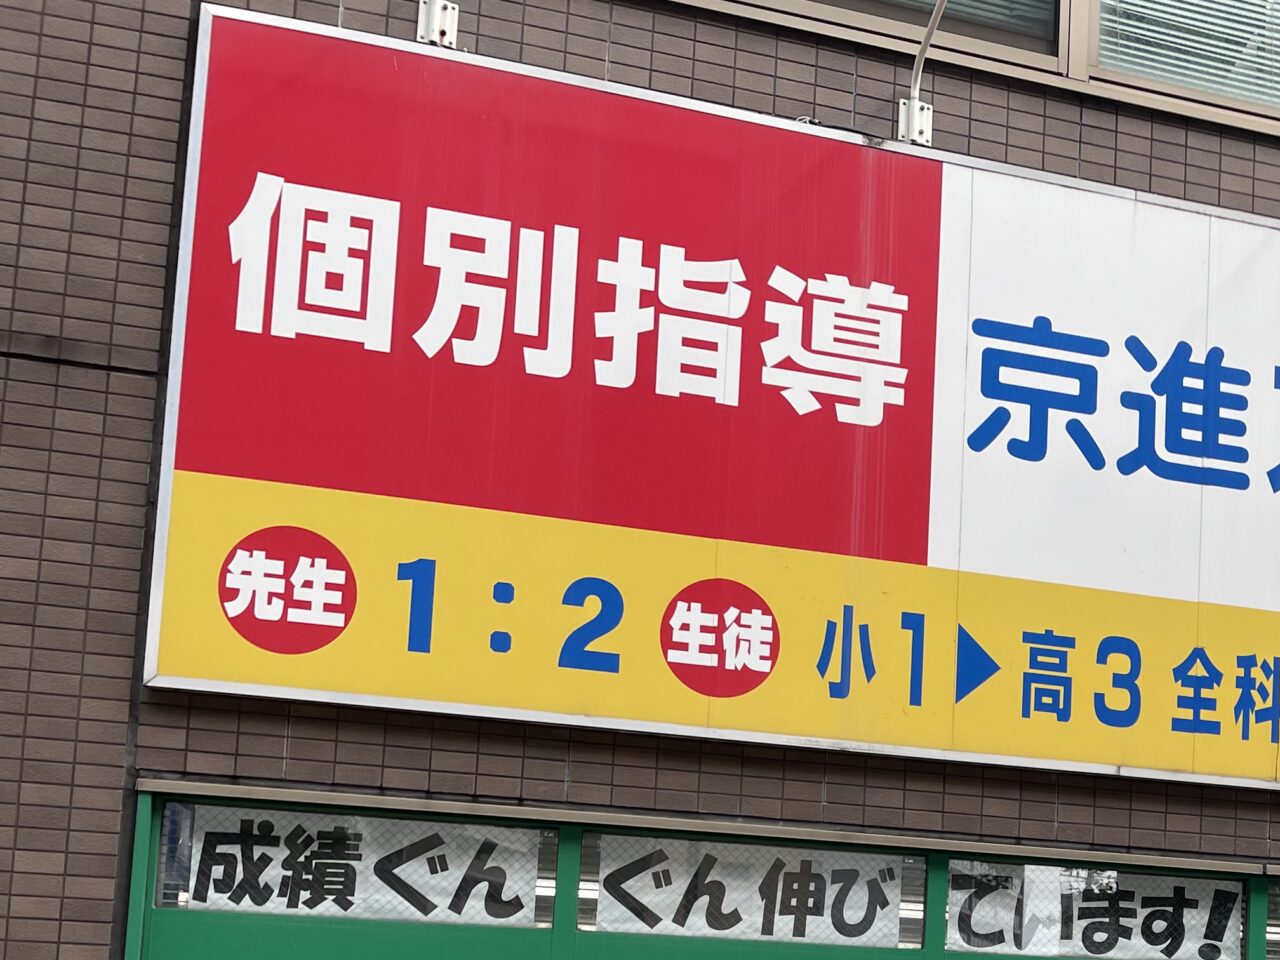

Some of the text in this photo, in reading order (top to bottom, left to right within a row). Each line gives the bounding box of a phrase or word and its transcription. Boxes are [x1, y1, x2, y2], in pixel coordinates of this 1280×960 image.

[228, 172, 909, 428] 個別指導
[223, 548, 346, 629] 先生
[668, 602, 773, 674] 生徒
[192, 819, 525, 919] 成績ぐん
[602, 848, 896, 938] ぐん伸び
